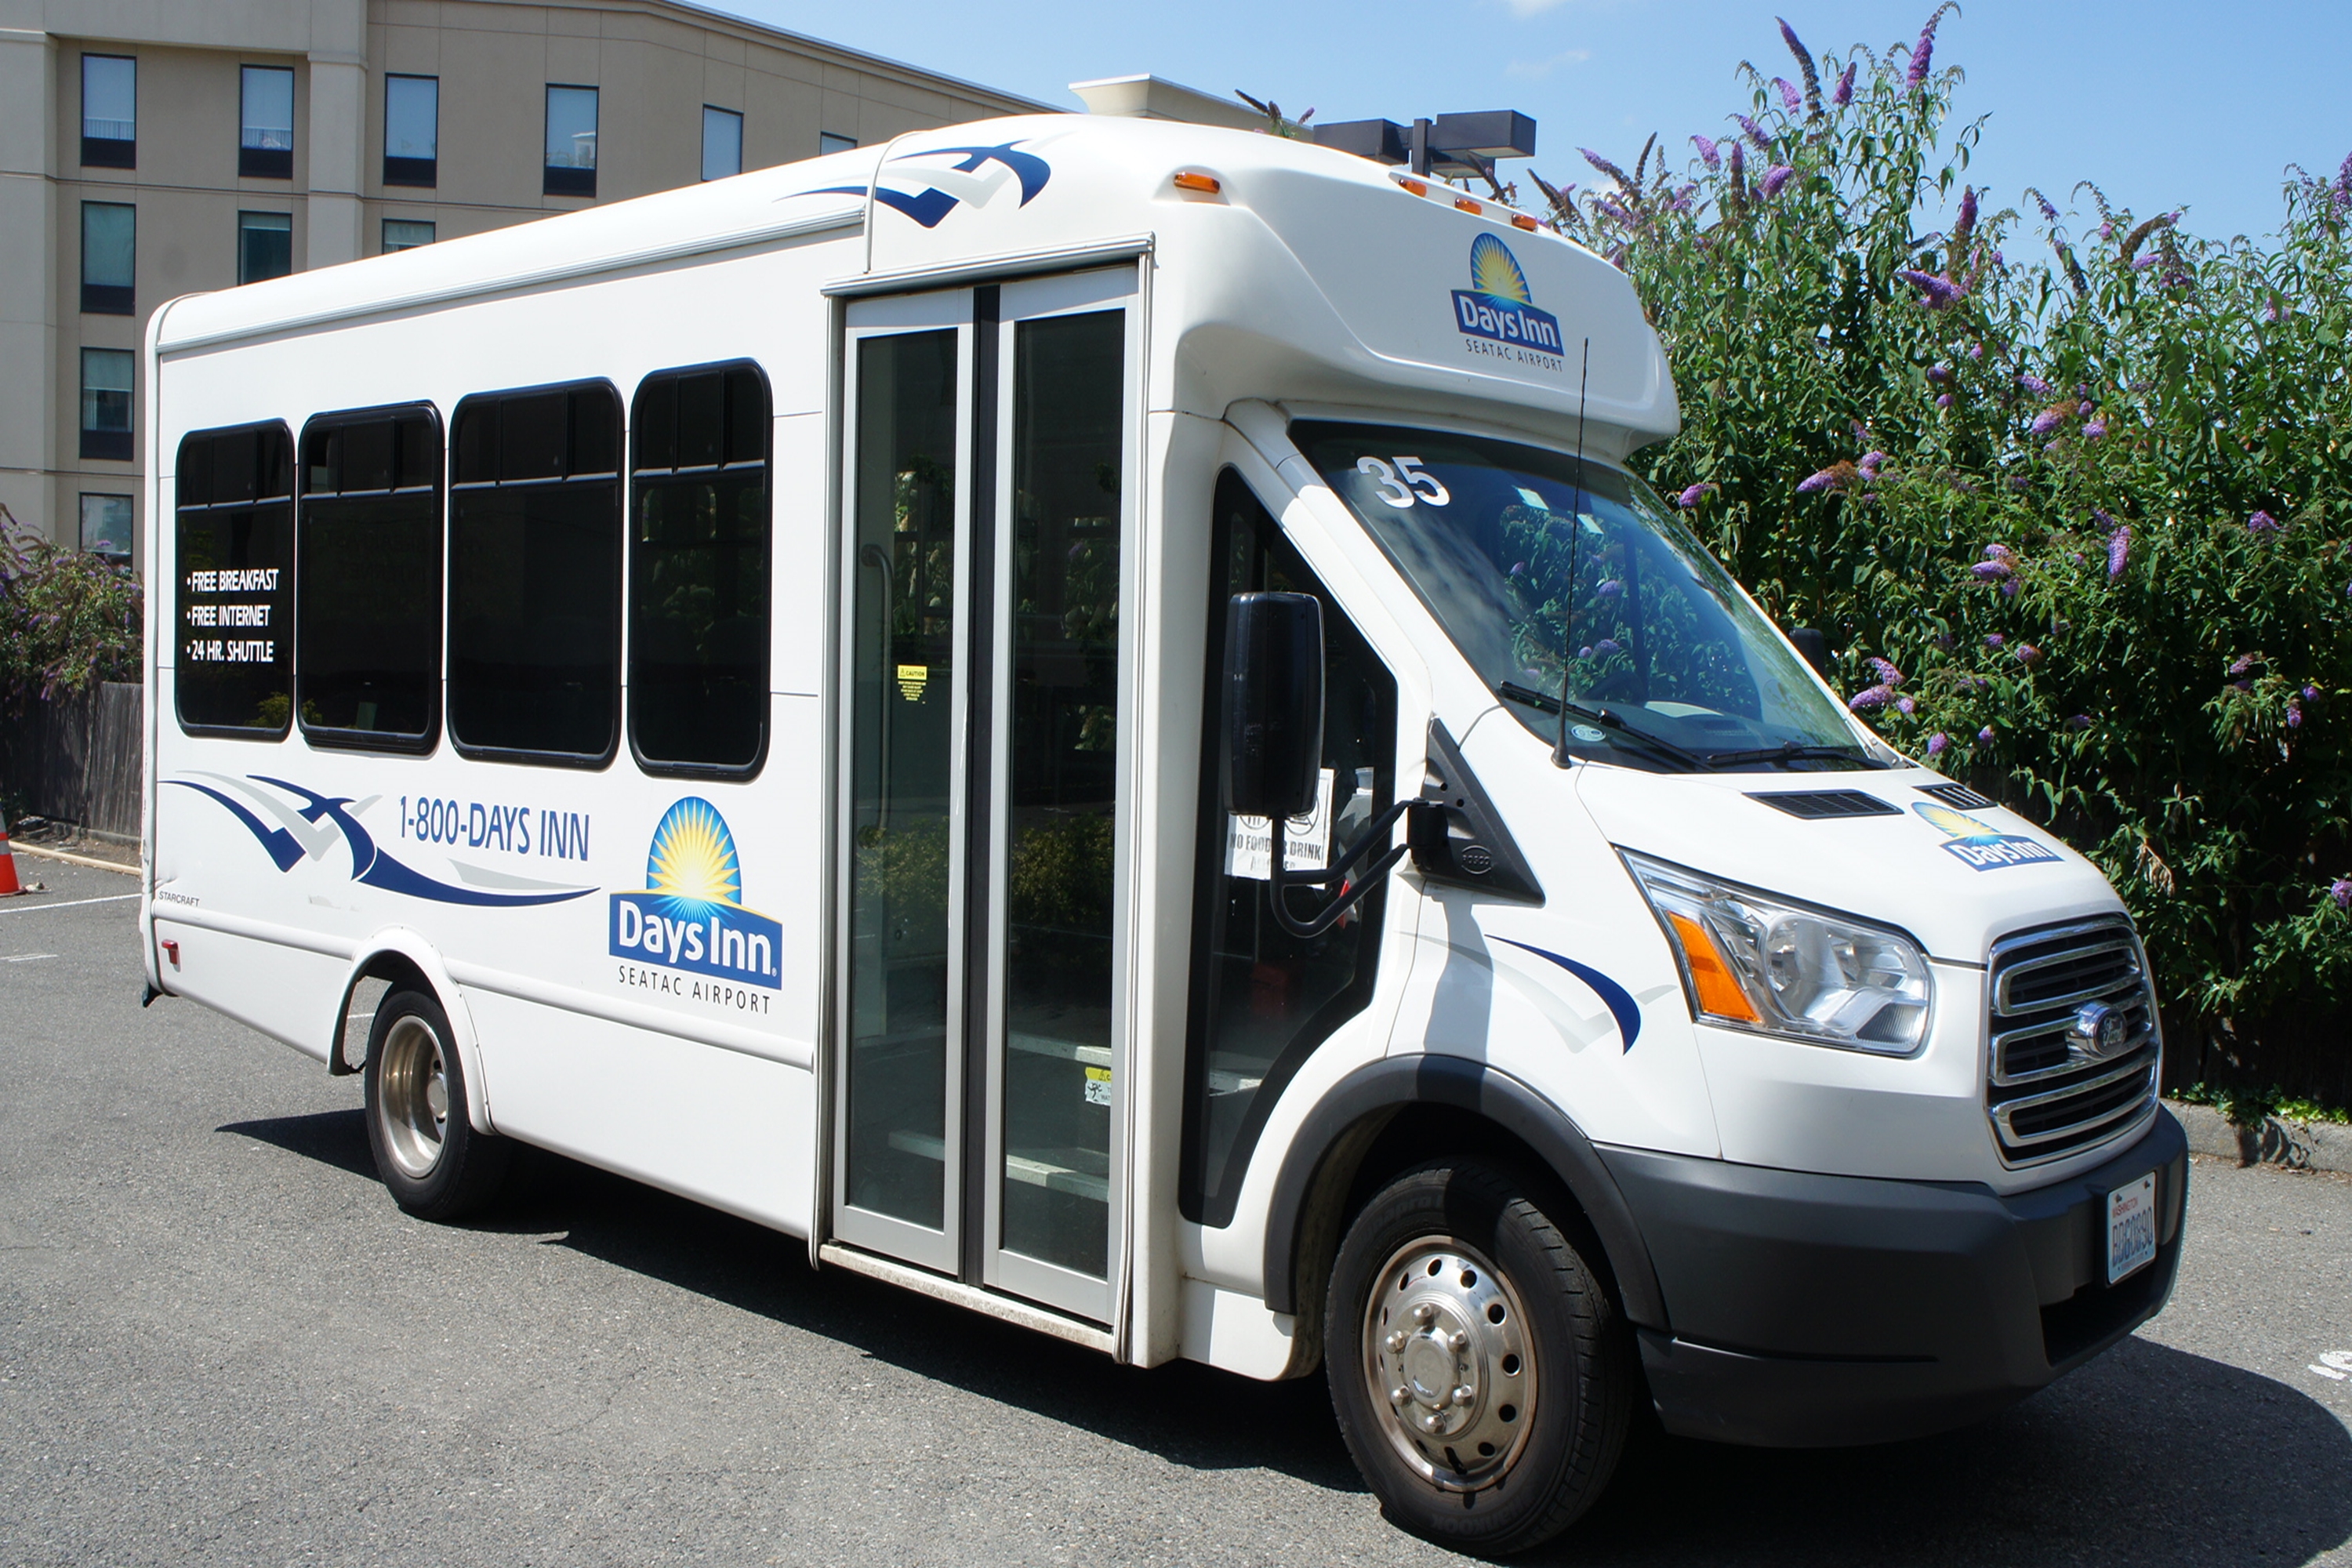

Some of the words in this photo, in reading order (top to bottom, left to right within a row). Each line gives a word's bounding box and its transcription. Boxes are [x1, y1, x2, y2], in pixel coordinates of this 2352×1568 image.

[1458, 295, 1519, 339] Days
[1517, 310, 1557, 347] Inn
[1465, 339, 1512, 361] SEATAC
[1517, 350, 1563, 372] AIRPORT
[1356, 456, 1450, 508] 35
[192, 570, 217, 591] FREE
[219, 568, 279, 590] BREAKFAST
[191, 605, 216, 626] FREE
[219, 604, 271, 626] INTERNET
[191, 640, 205, 661] 24
[206, 640, 224, 661] HR.
[227, 641, 274, 662] SHUTTLE
[400, 795, 531, 855] 1-800-DAYS
[539, 810, 590, 862] INN
[1229, 832, 1244, 851] NO
[1246, 835, 1272, 853] FOOD
[1289, 840, 1322, 861] DRINK
[1947, 842, 2021, 866] Days
[1998, 839, 2055, 859] Inn
[158, 891, 200, 906] STARCRAFT
[619, 899, 704, 964] Days
[710, 916, 772, 975] Inn
[619, 964, 682, 996] SEATAC
[691, 981, 770, 1014] AIRPORT
[2112, 1196, 2138, 1218] WASHINGTON
